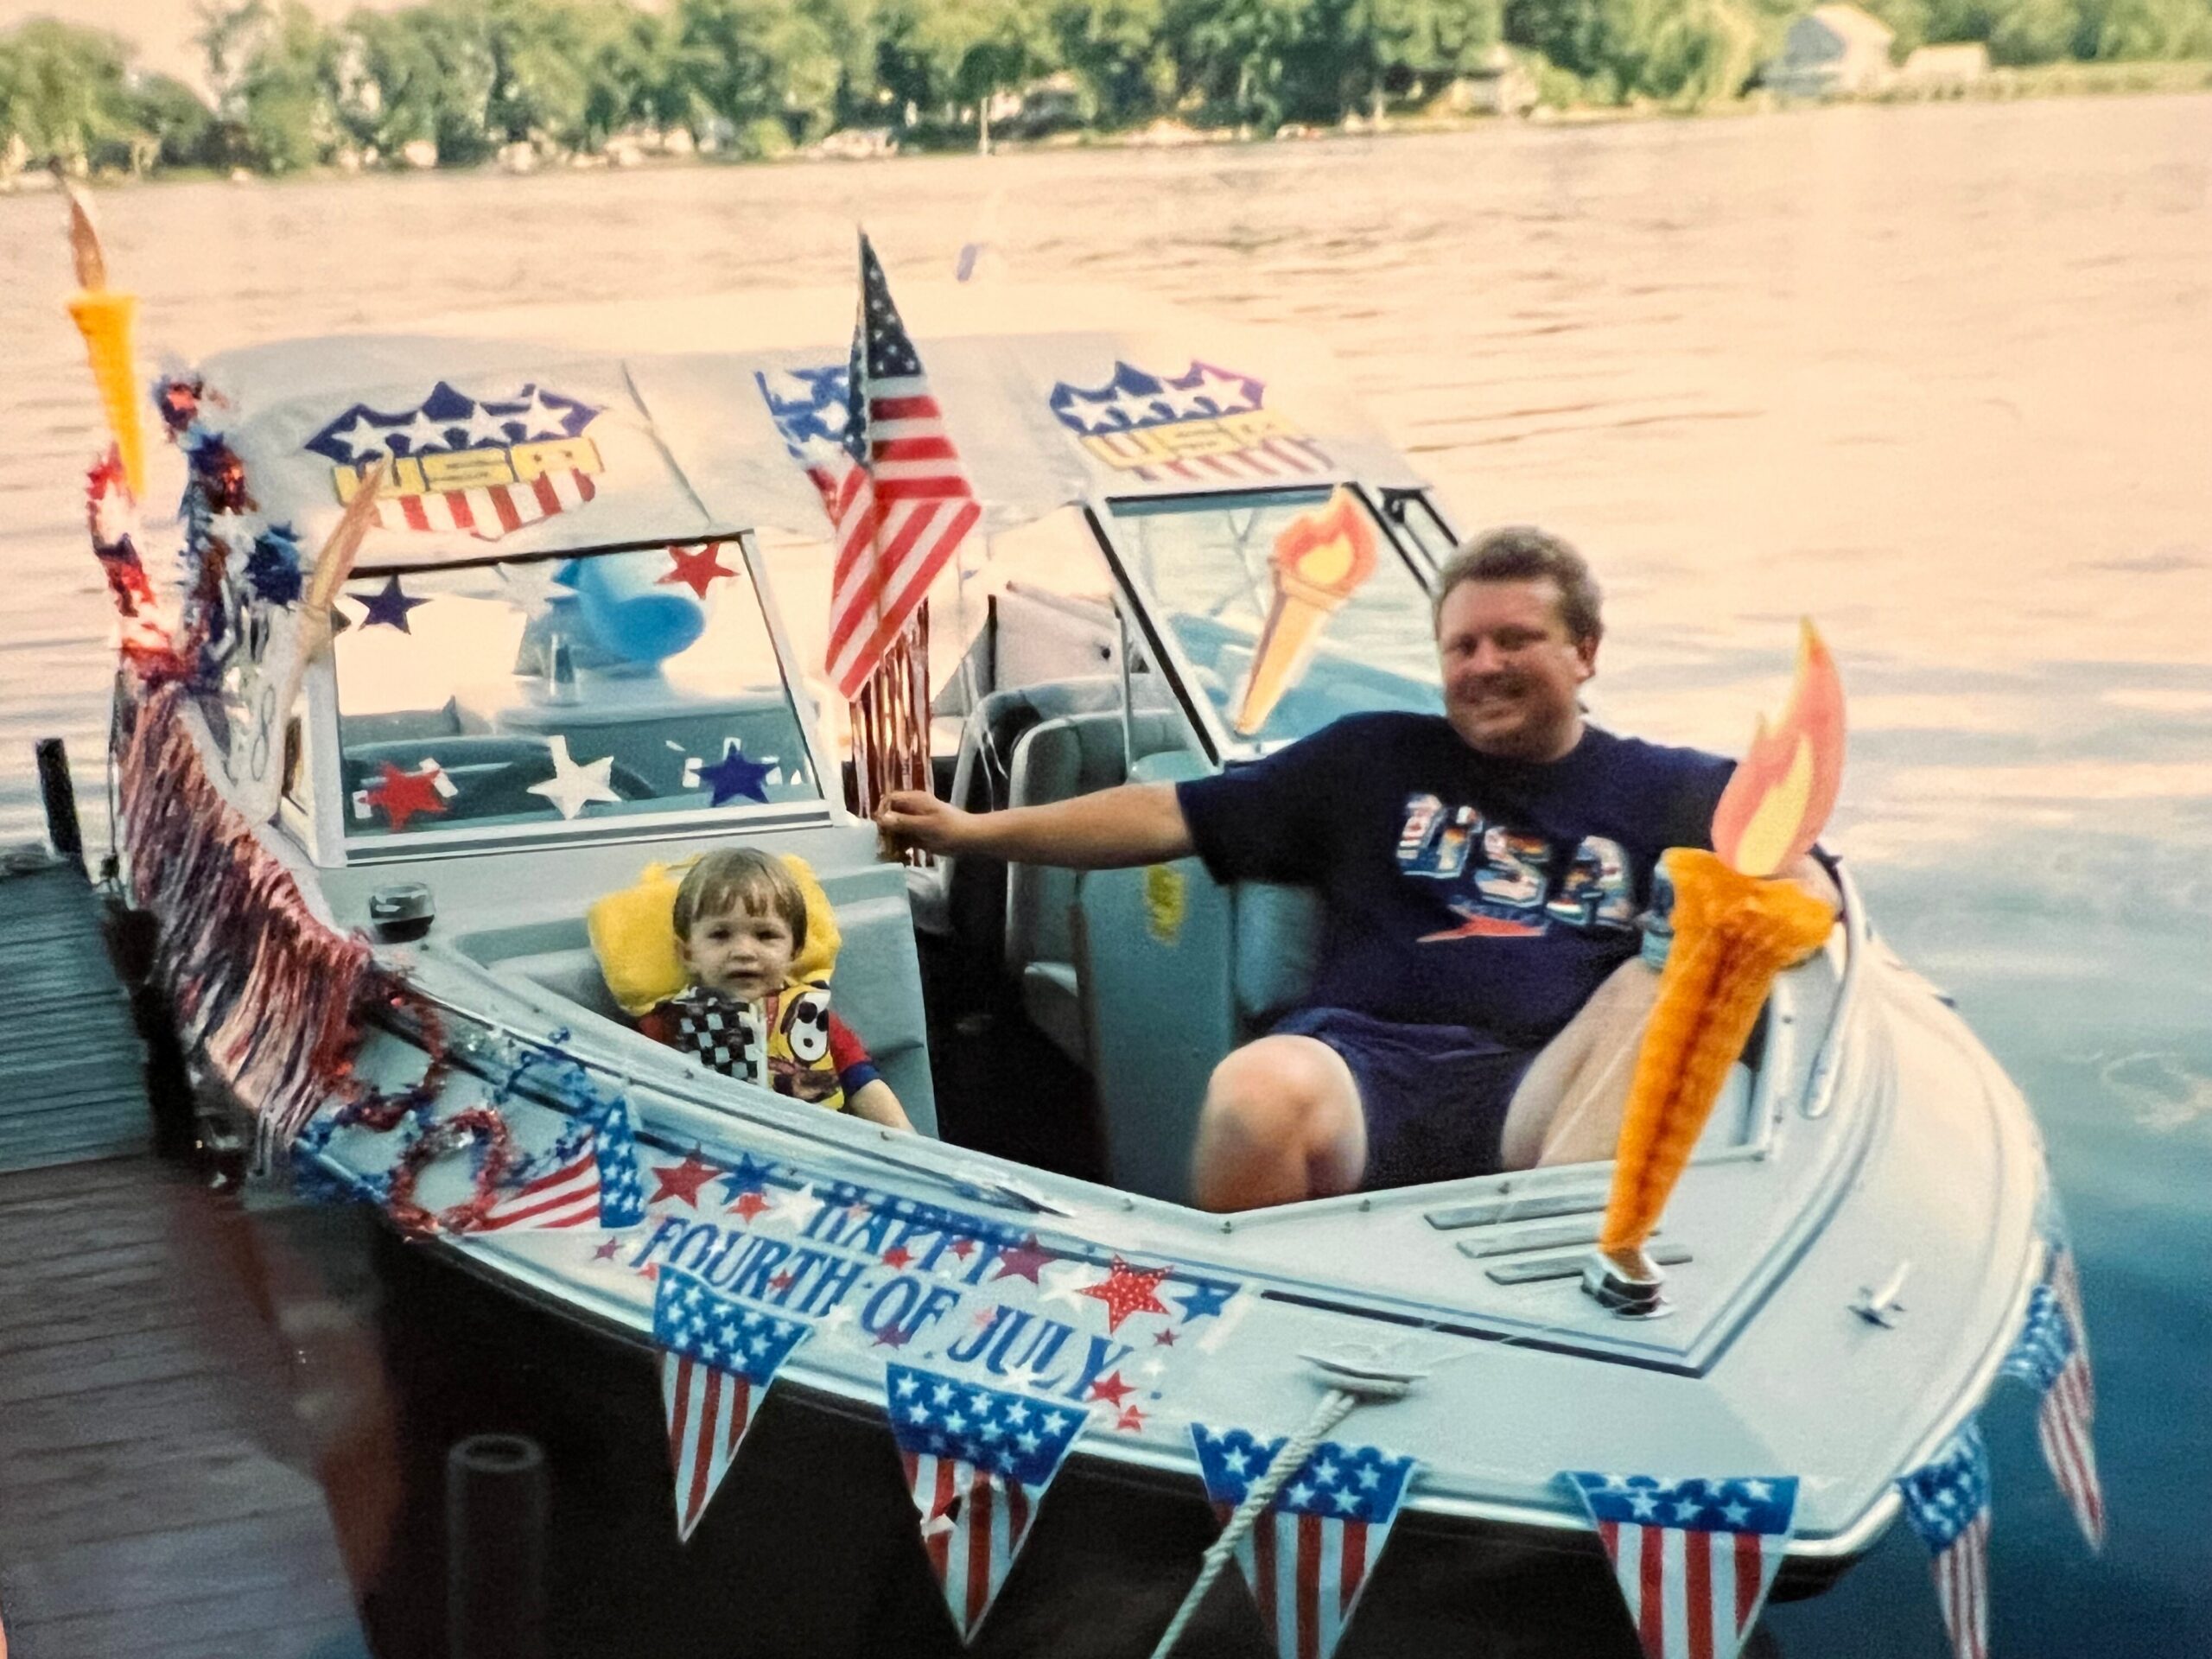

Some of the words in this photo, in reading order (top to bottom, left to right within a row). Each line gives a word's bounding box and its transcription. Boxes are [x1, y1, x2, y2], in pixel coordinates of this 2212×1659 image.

[629, 1215, 866, 1320] FOURTH
[860, 1274, 962, 1344] OF
[947, 1304, 1135, 1401] JULY
